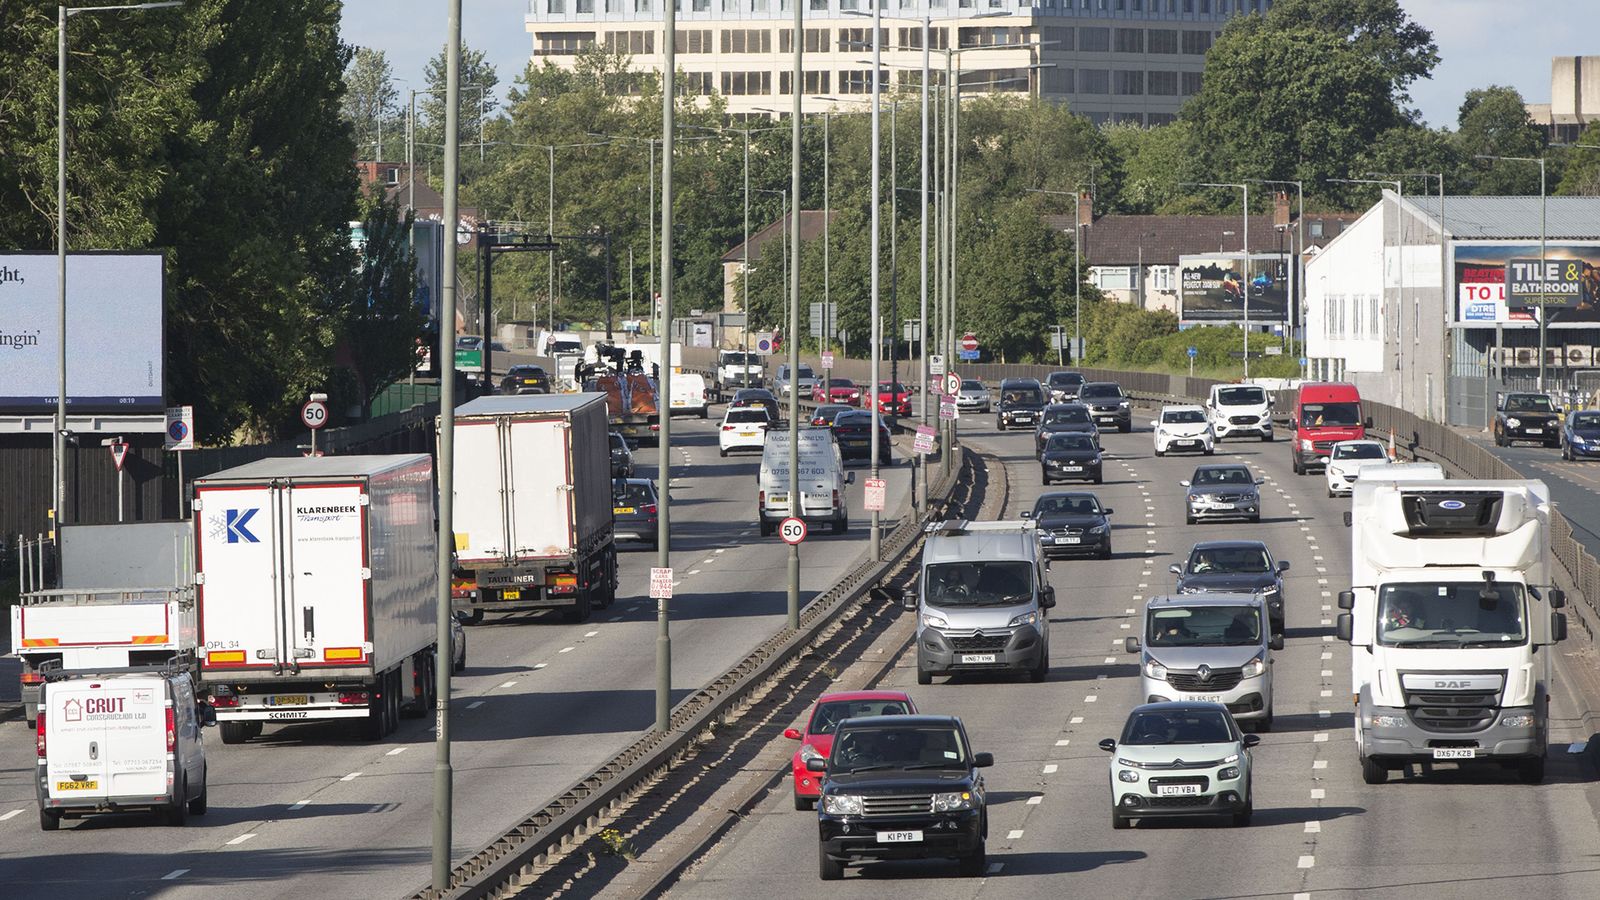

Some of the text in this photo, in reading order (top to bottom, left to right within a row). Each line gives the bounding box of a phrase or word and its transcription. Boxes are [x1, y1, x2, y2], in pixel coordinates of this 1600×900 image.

[1512, 263, 1560, 281] TILE
[1565, 263, 1579, 281] &
[1512, 282, 1579, 293] BATHROOM
[1465, 286, 1491, 300] TO
[306, 408, 324, 420] 50
[297, 505, 356, 514] KLARENBEEK
[298, 514, 341, 523] Transport
[784, 525, 802, 536] 50
[488, 575, 534, 584] TAUTLINER
[206, 640, 240, 650] OPL 34
[1434, 681, 1471, 689] DAF
[86, 698, 126, 714] CRUT
[269, 711, 308, 719] SCHMITZ
[1436, 750, 1472, 758] DX67 KZB
[60, 782, 80, 790] FG62
[1161, 786, 1196, 795] LC17 VBA
[897, 833, 913, 841] PYB
